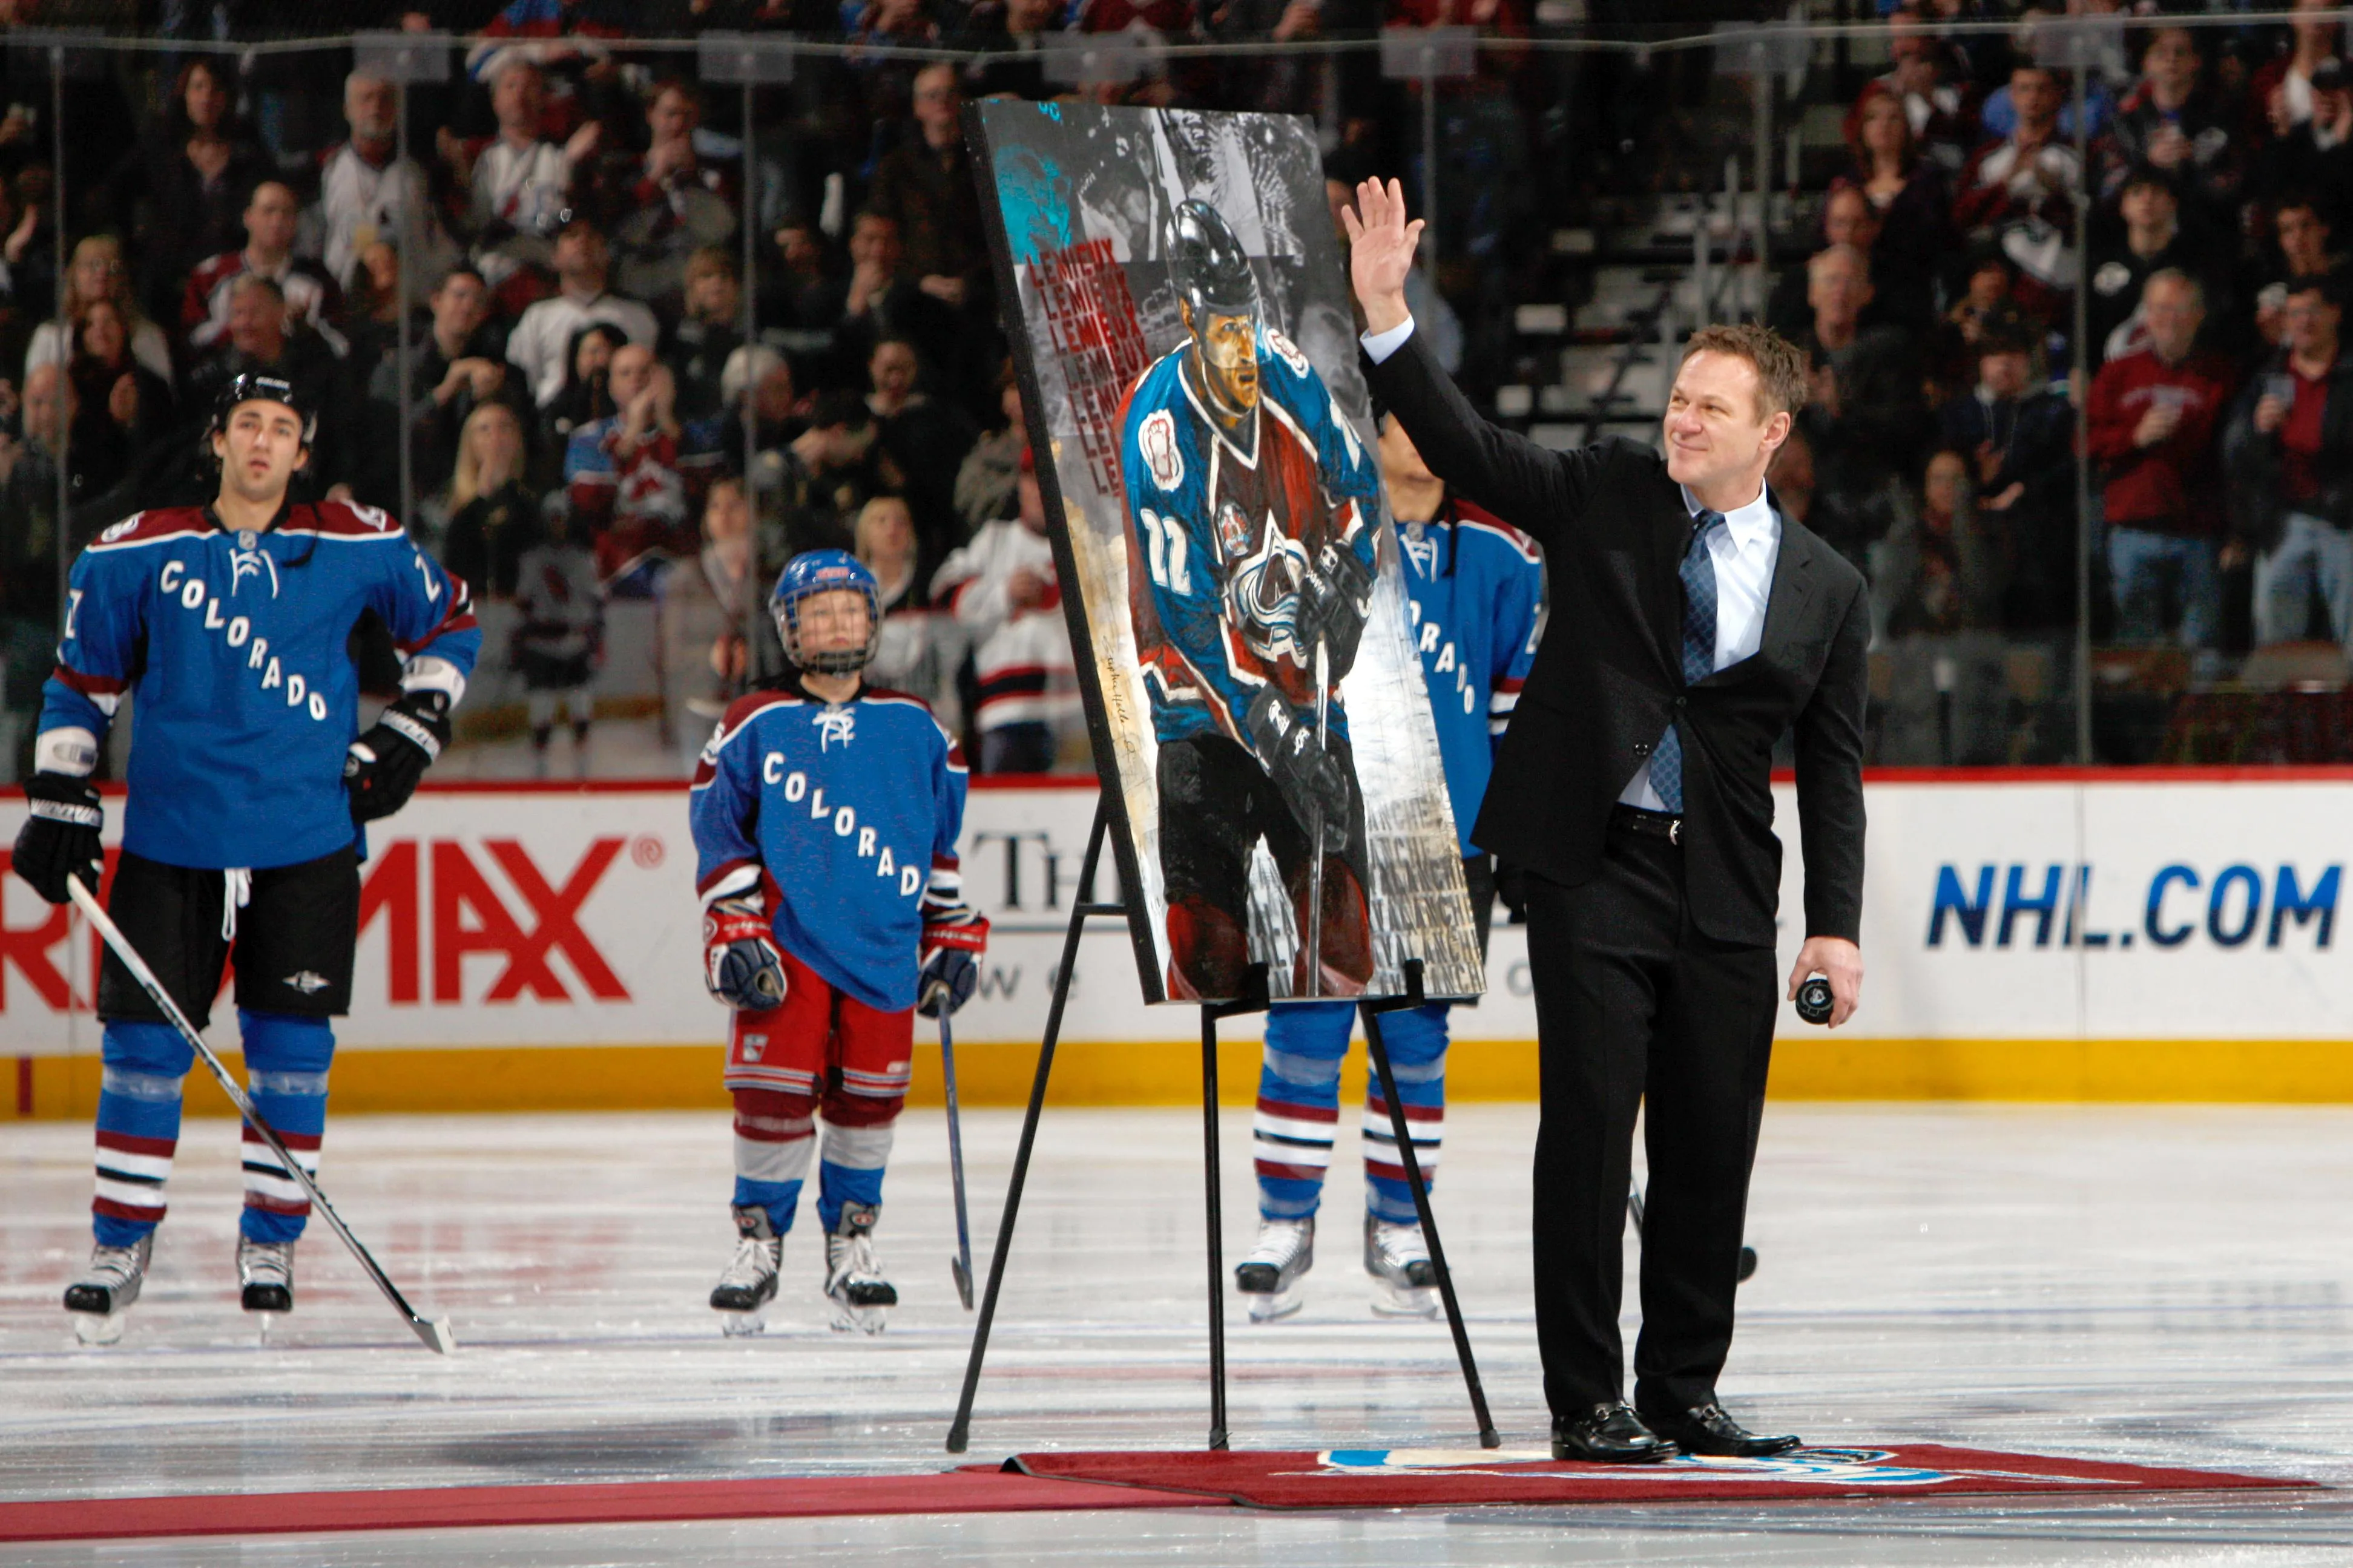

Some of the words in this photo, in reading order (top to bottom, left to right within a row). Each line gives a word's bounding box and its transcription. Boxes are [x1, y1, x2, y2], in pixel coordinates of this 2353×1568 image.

[160, 560, 327, 722] COLORADO
[763, 752, 927, 912] COLORAD
[1926, 864, 2343, 950] NHL.COM
